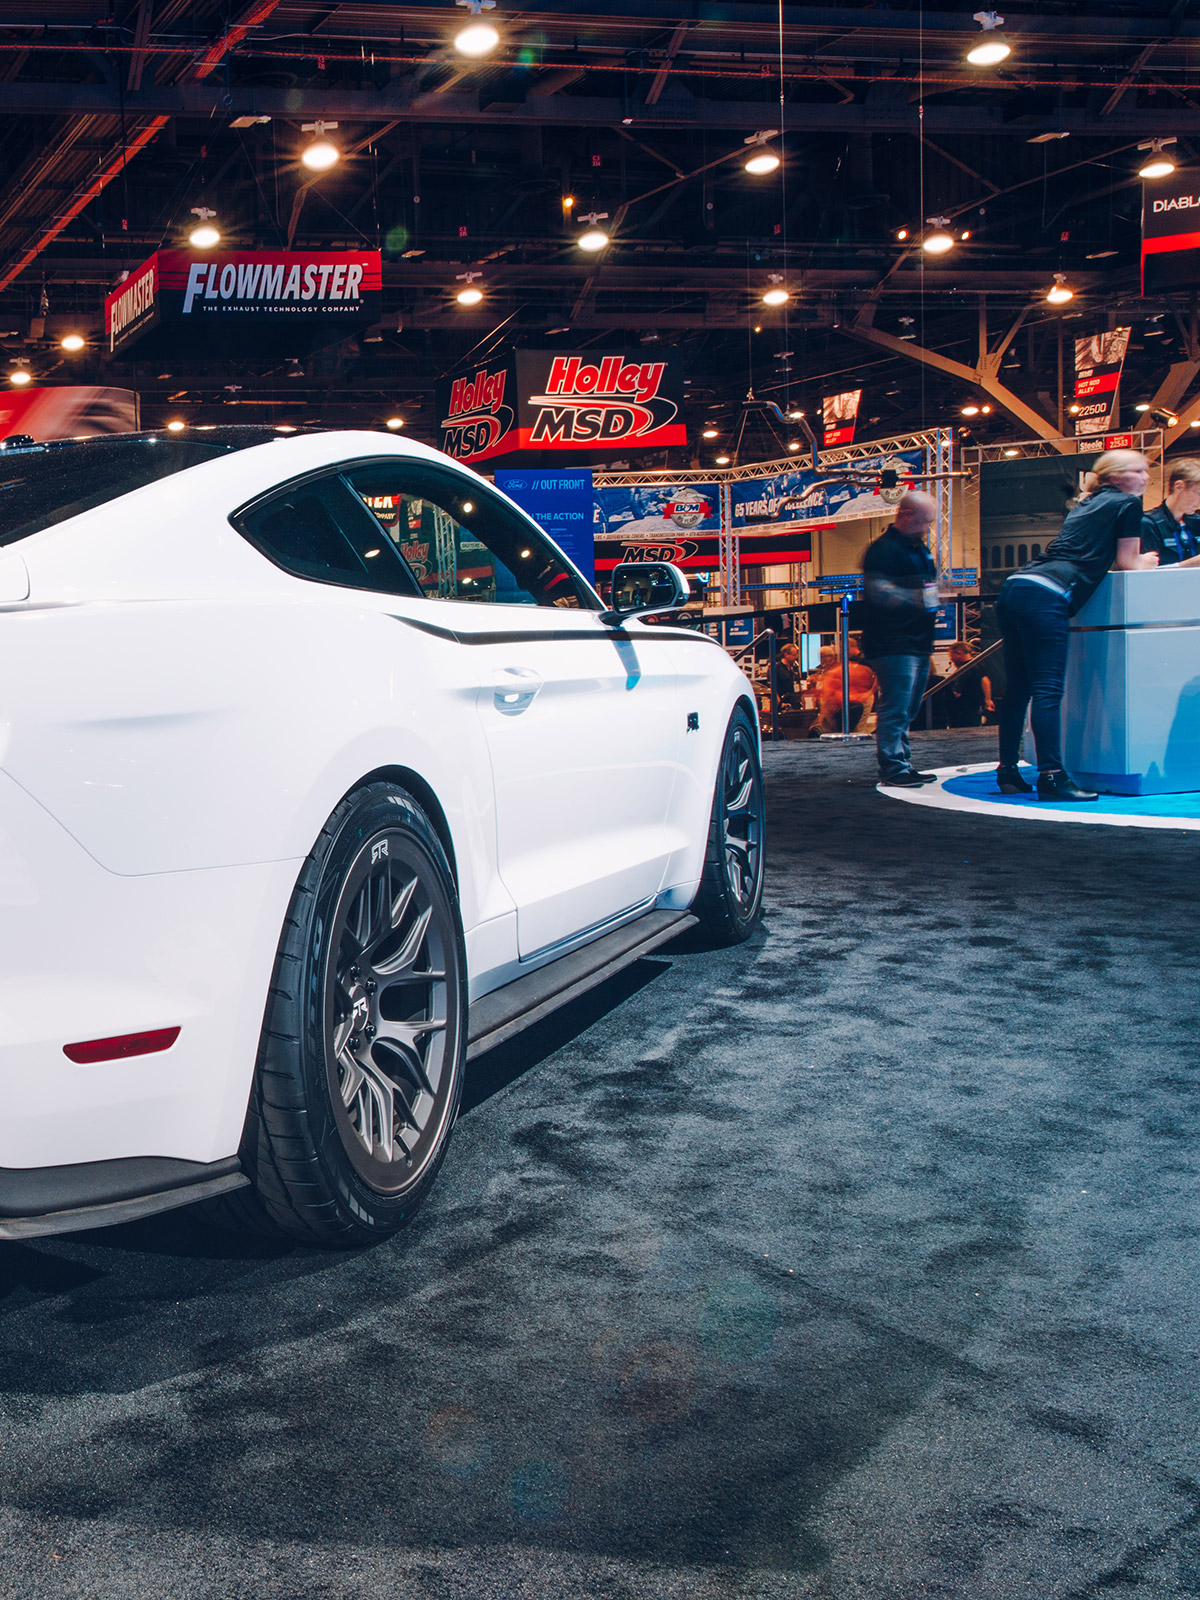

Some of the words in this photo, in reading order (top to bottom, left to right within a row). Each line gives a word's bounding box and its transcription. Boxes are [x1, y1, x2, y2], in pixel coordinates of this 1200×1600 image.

[1153, 195, 1200, 213] DIABL
[182, 263, 363, 313] FLOWMASTER
[110, 268, 154, 353] FLOWMASTER
[449, 369, 508, 416] Holley
[545, 356, 665, 403] Holley
[1078, 402, 1107, 417] 22500
[529, 408, 634, 443] MSD
[443, 419, 492, 460] MSD
[540, 479, 558, 490] OUT
[558, 479, 585, 490] FRONT
[553, 512, 584, 520] ACTION
[735, 503, 745, 517] 65
[622, 546, 676, 563] MSD
